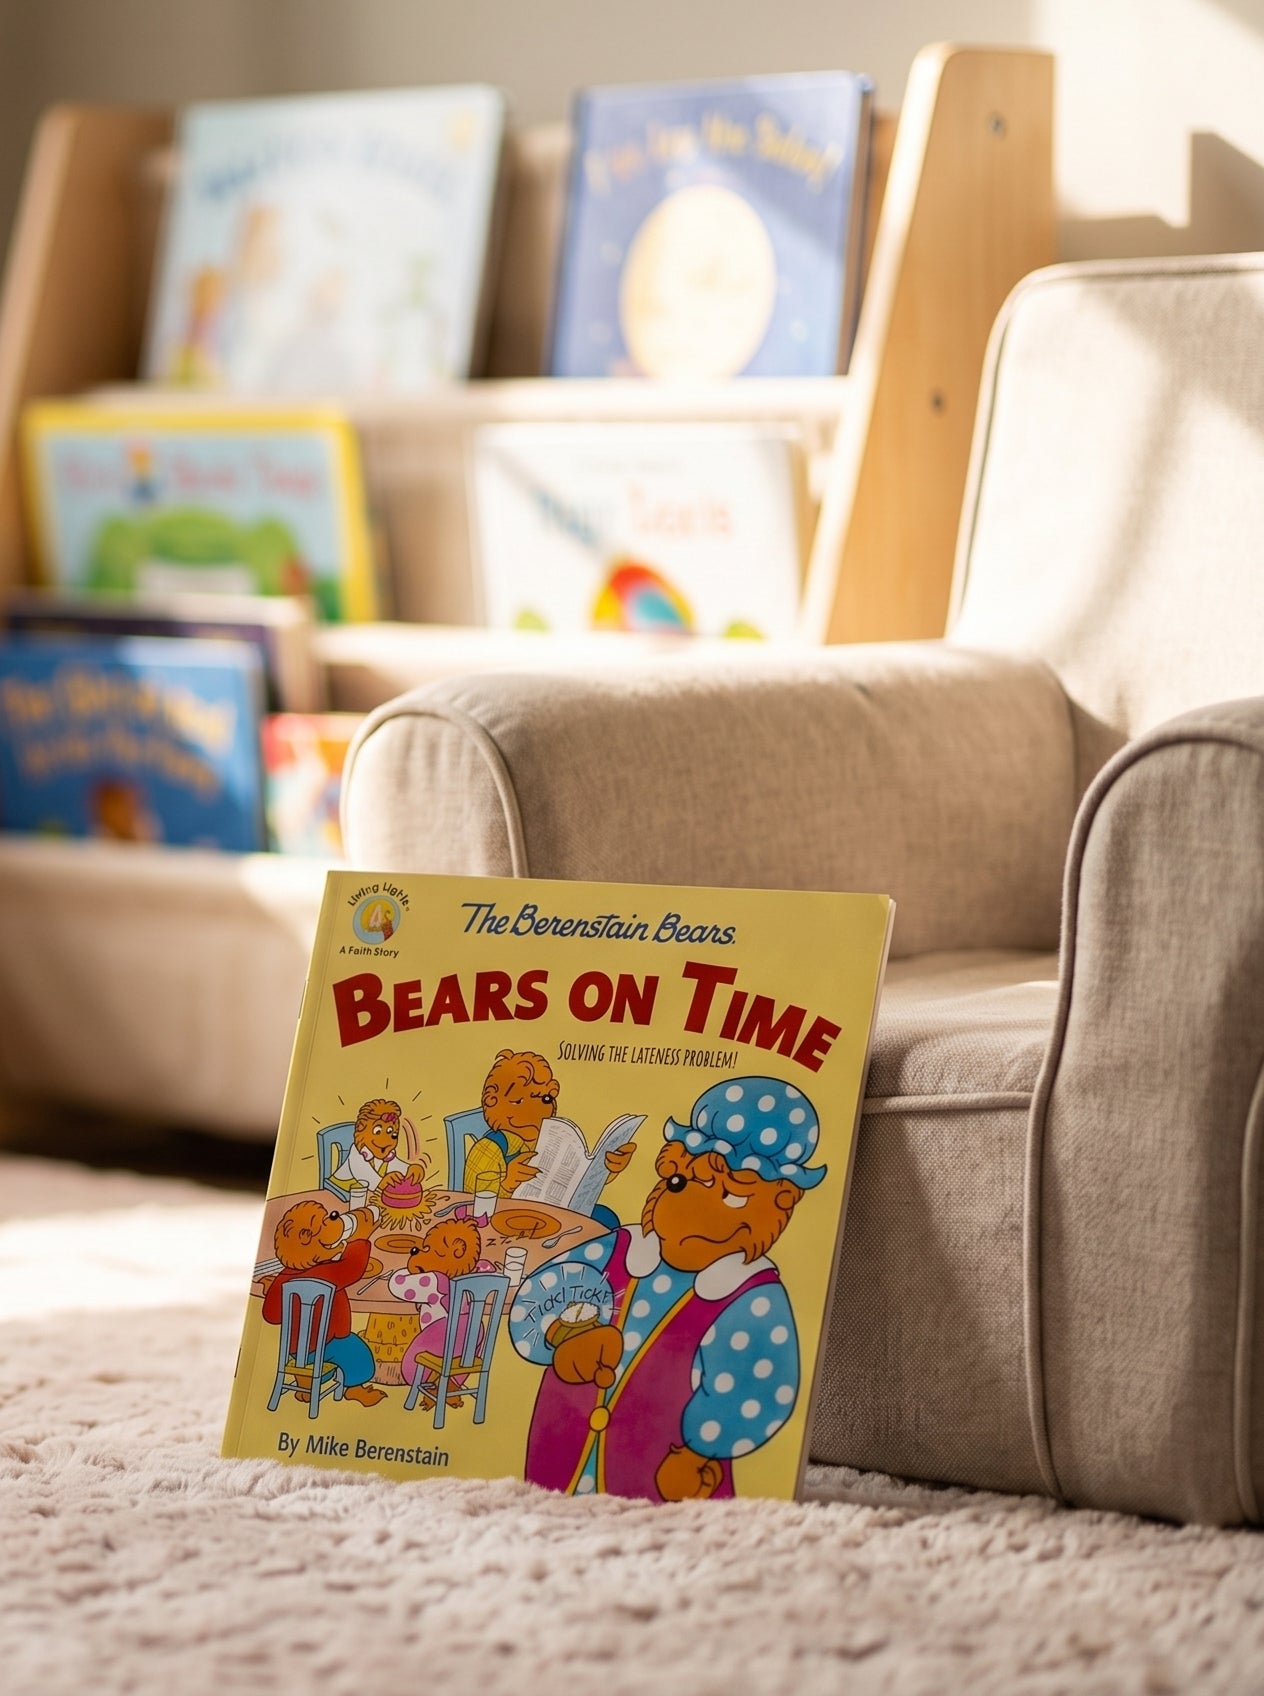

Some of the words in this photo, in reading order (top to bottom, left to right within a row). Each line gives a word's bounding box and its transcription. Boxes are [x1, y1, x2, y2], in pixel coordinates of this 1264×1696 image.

[461, 902, 508, 935] The
[510, 903, 649, 942] Berenstain
[339, 945, 346, 954] A
[348, 946, 372, 956] Faith
[373, 947, 400, 959] Story
[332, 969, 549, 1048] BEARS
[568, 970, 660, 1026] ON
[682, 960, 843, 1073] TIME
[557, 1040, 606, 1062] SOLVING
[609, 1045, 629, 1063] THE
[631, 1047, 682, 1066] LATENESS
[683, 1048, 739, 1069] PROBLEM!
[278, 1431, 301, 1458] By
[305, 1434, 349, 1457] Mike
[354, 1438, 450, 1467] Berenstain
